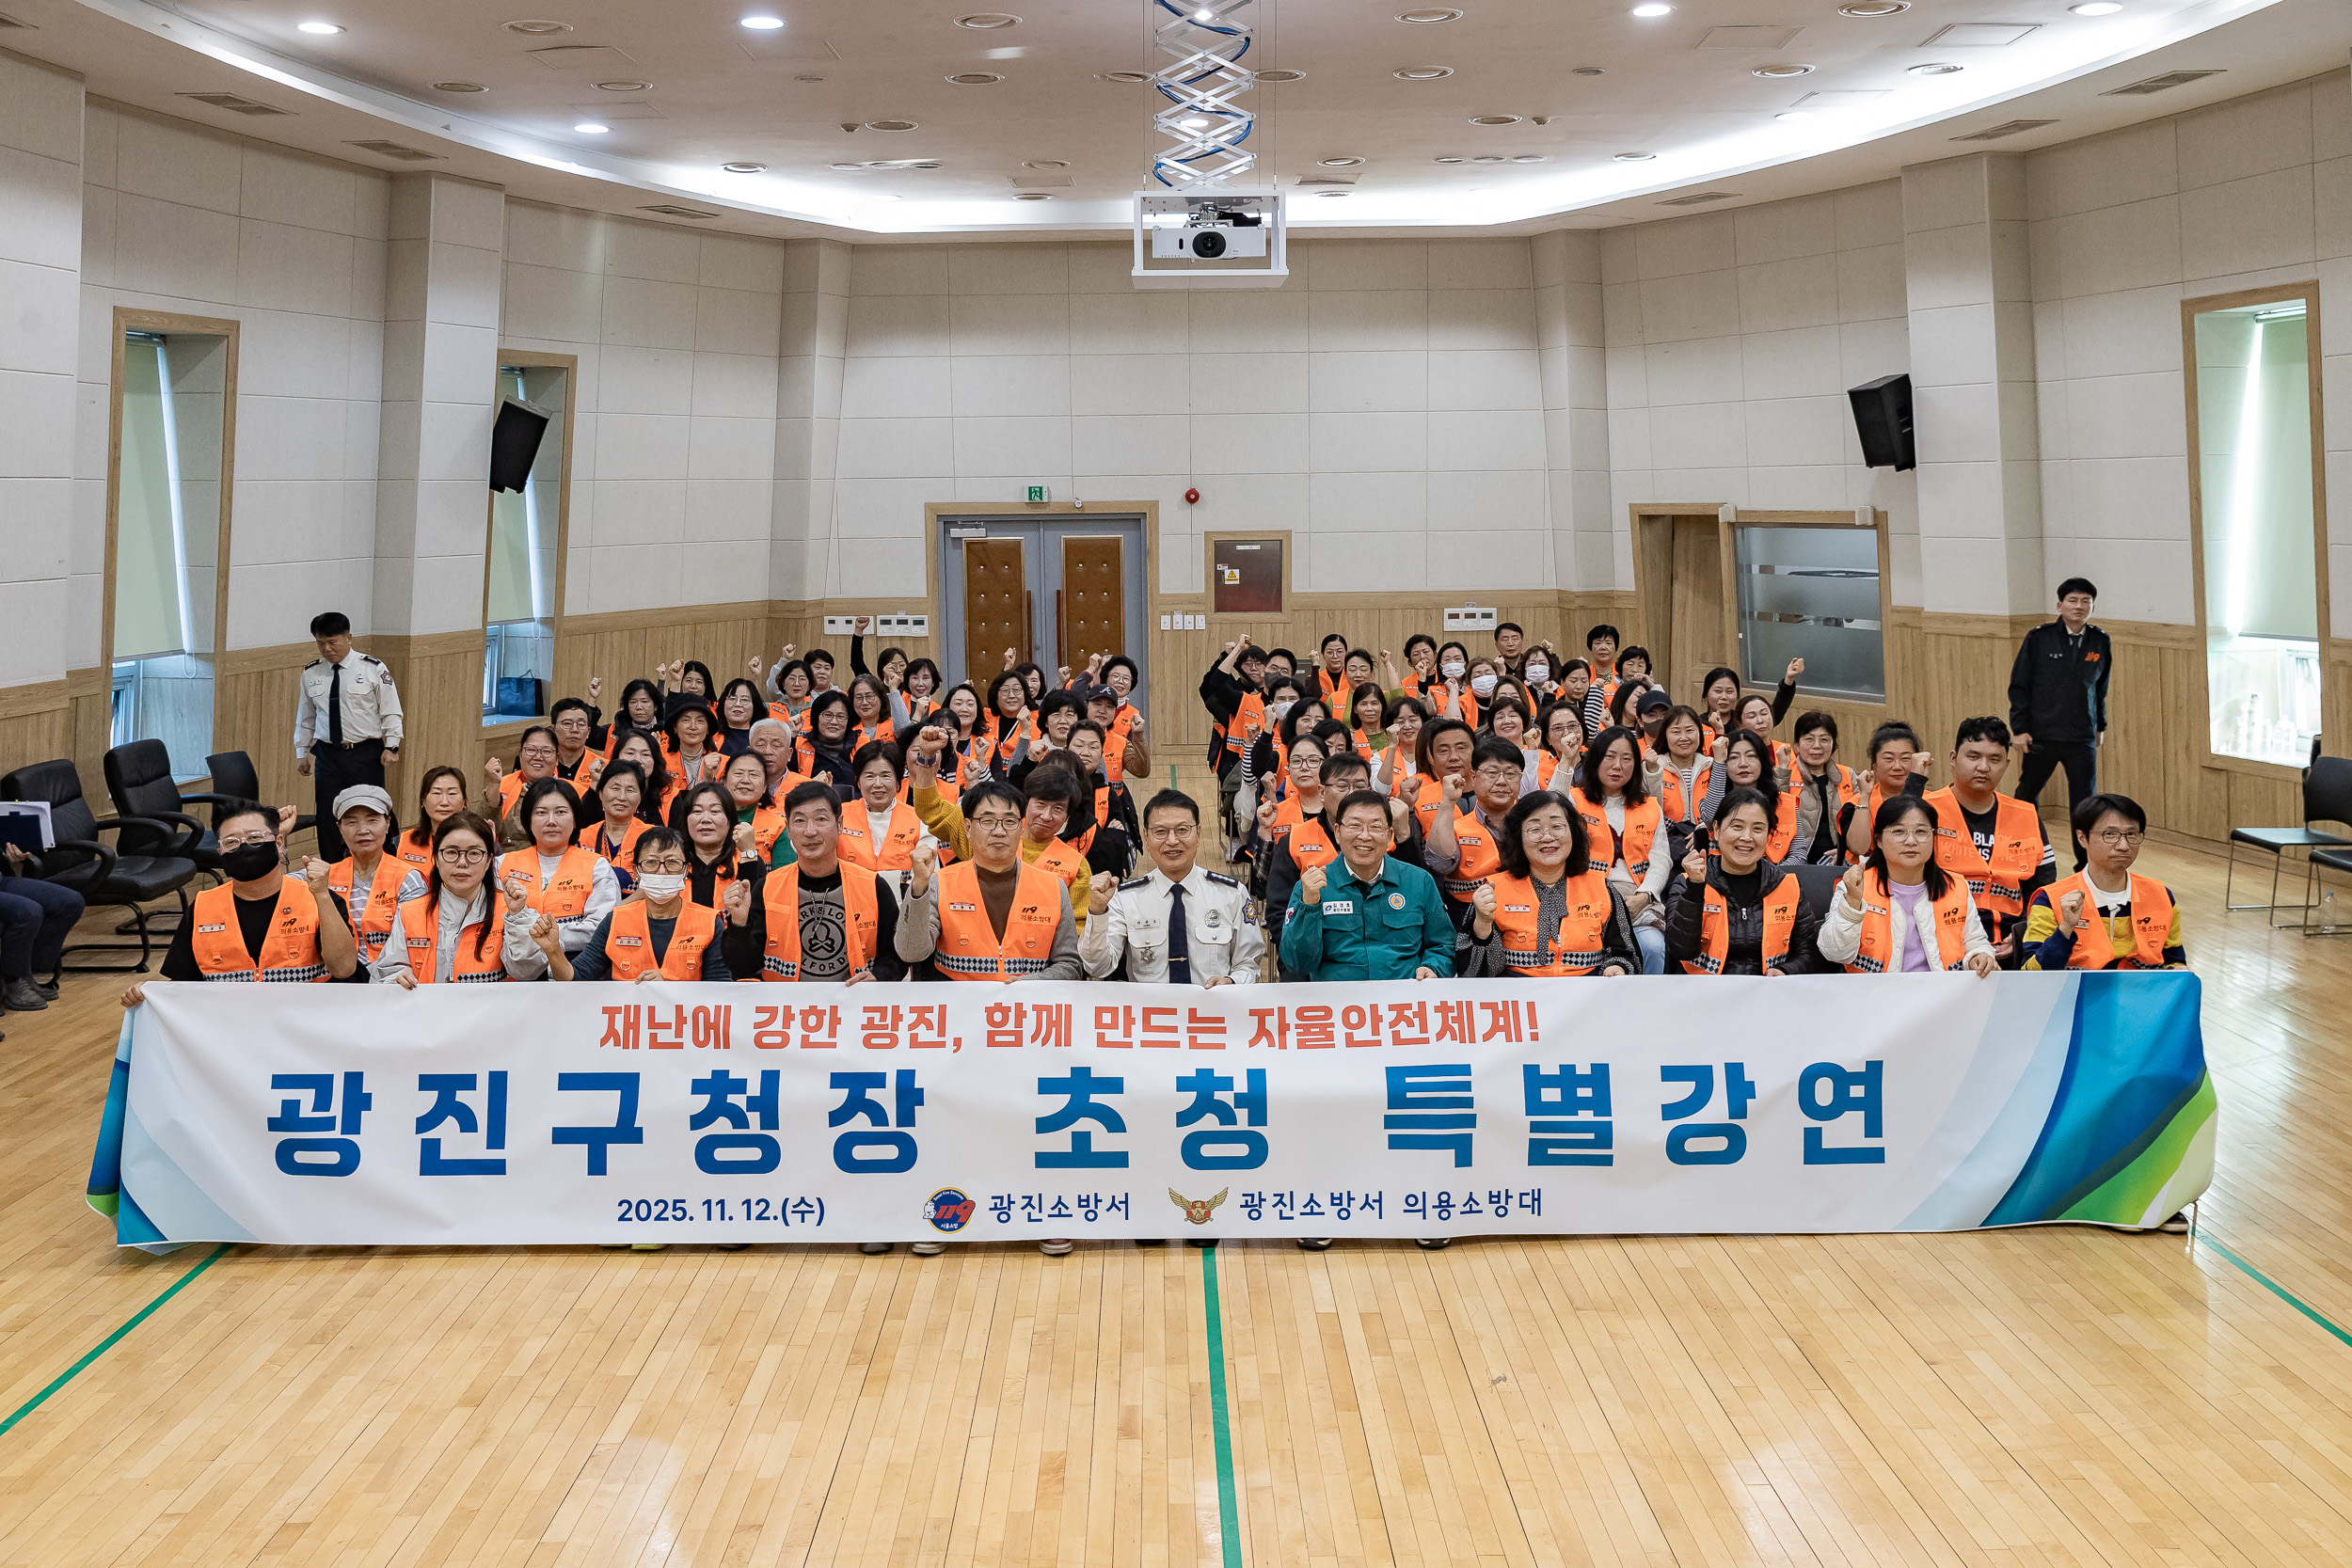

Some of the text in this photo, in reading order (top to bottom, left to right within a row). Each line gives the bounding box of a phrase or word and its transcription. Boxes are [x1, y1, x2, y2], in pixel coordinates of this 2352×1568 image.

[1046, 859, 1062, 867] 119
[1020, 914, 1052, 924] 의용소방대
[1773, 906, 1788, 915] 119
[1943, 907, 1959, 919] 119
[599, 1000, 1540, 1053] 재난에 강한 광진, 함께 만드는 자율안전체계!
[267, 1060, 1885, 1178] 광진구청장 초청 특별강연
[617, 1196, 826, 1227] 2025. 11. 12.(수)
[934, 1200, 976, 1223] 119
[988, 1192, 1130, 1224] 광진소방서
[1239, 1188, 1543, 1222] 광진소방서 의용소방대
